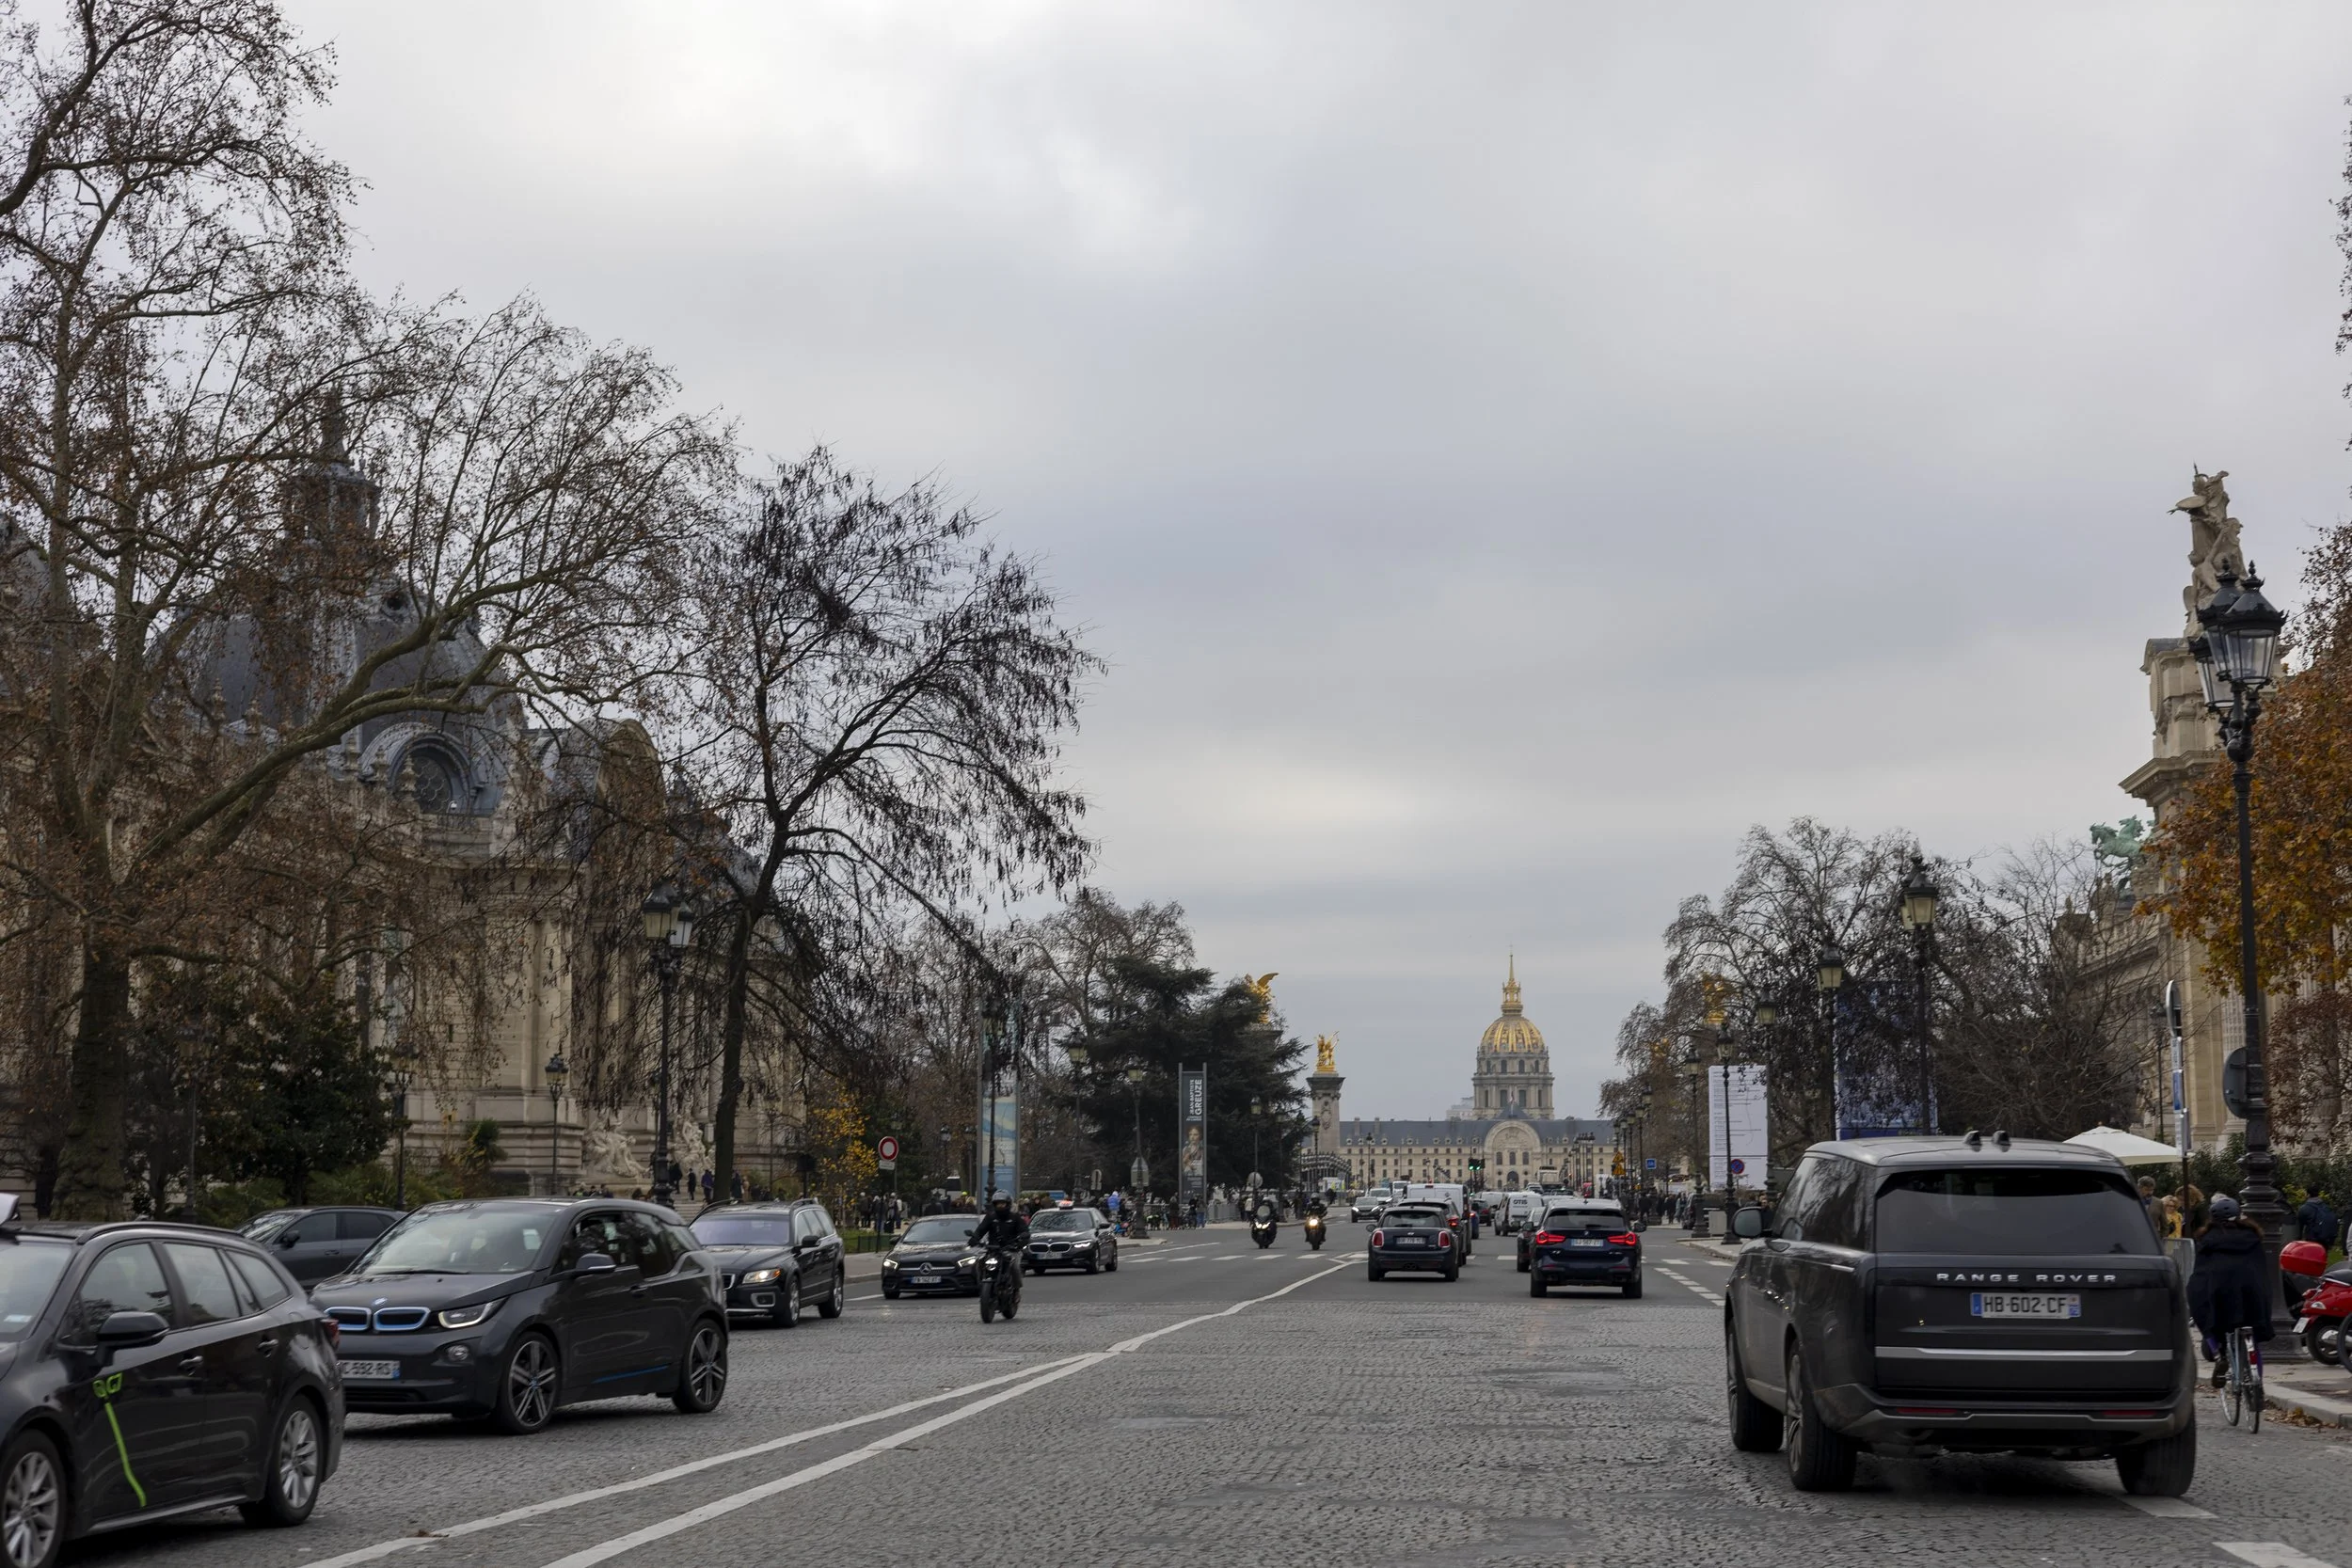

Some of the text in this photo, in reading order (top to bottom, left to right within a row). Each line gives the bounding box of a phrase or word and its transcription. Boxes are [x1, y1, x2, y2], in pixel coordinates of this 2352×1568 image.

[1936, 1273, 2117, 1283] RANGE ROVER
[1983, 1296, 2067, 1314] HB-602-CF
